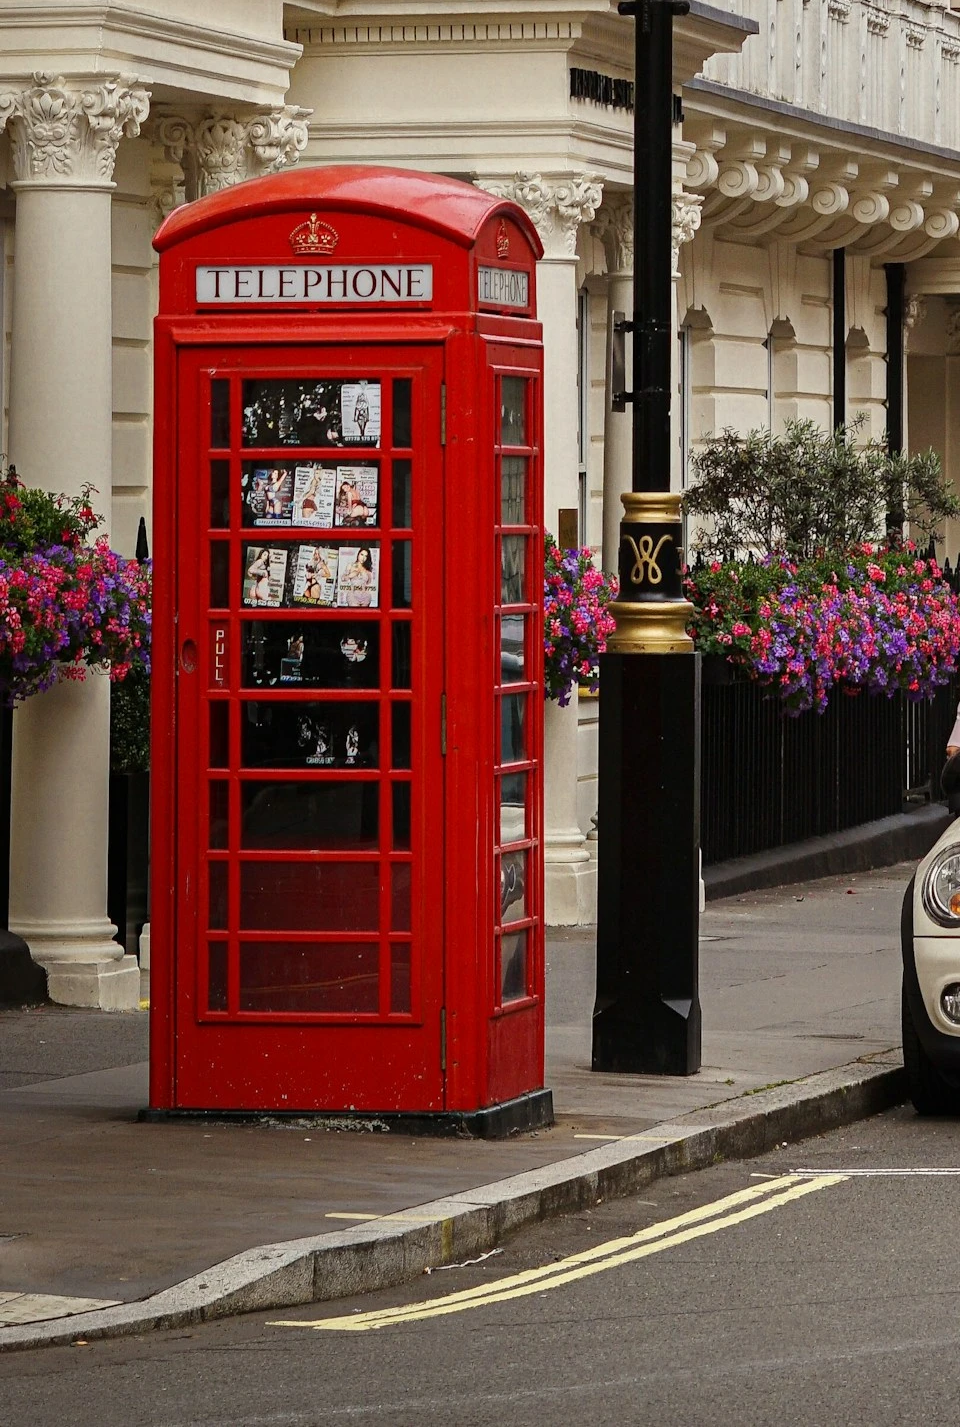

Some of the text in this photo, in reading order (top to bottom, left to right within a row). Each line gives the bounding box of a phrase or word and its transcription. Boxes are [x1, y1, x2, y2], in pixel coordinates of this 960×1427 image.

[207, 269, 424, 298] TELEPHONE
[478, 270, 527, 304] TELEPHONE
[215, 629, 225, 681] PULL
